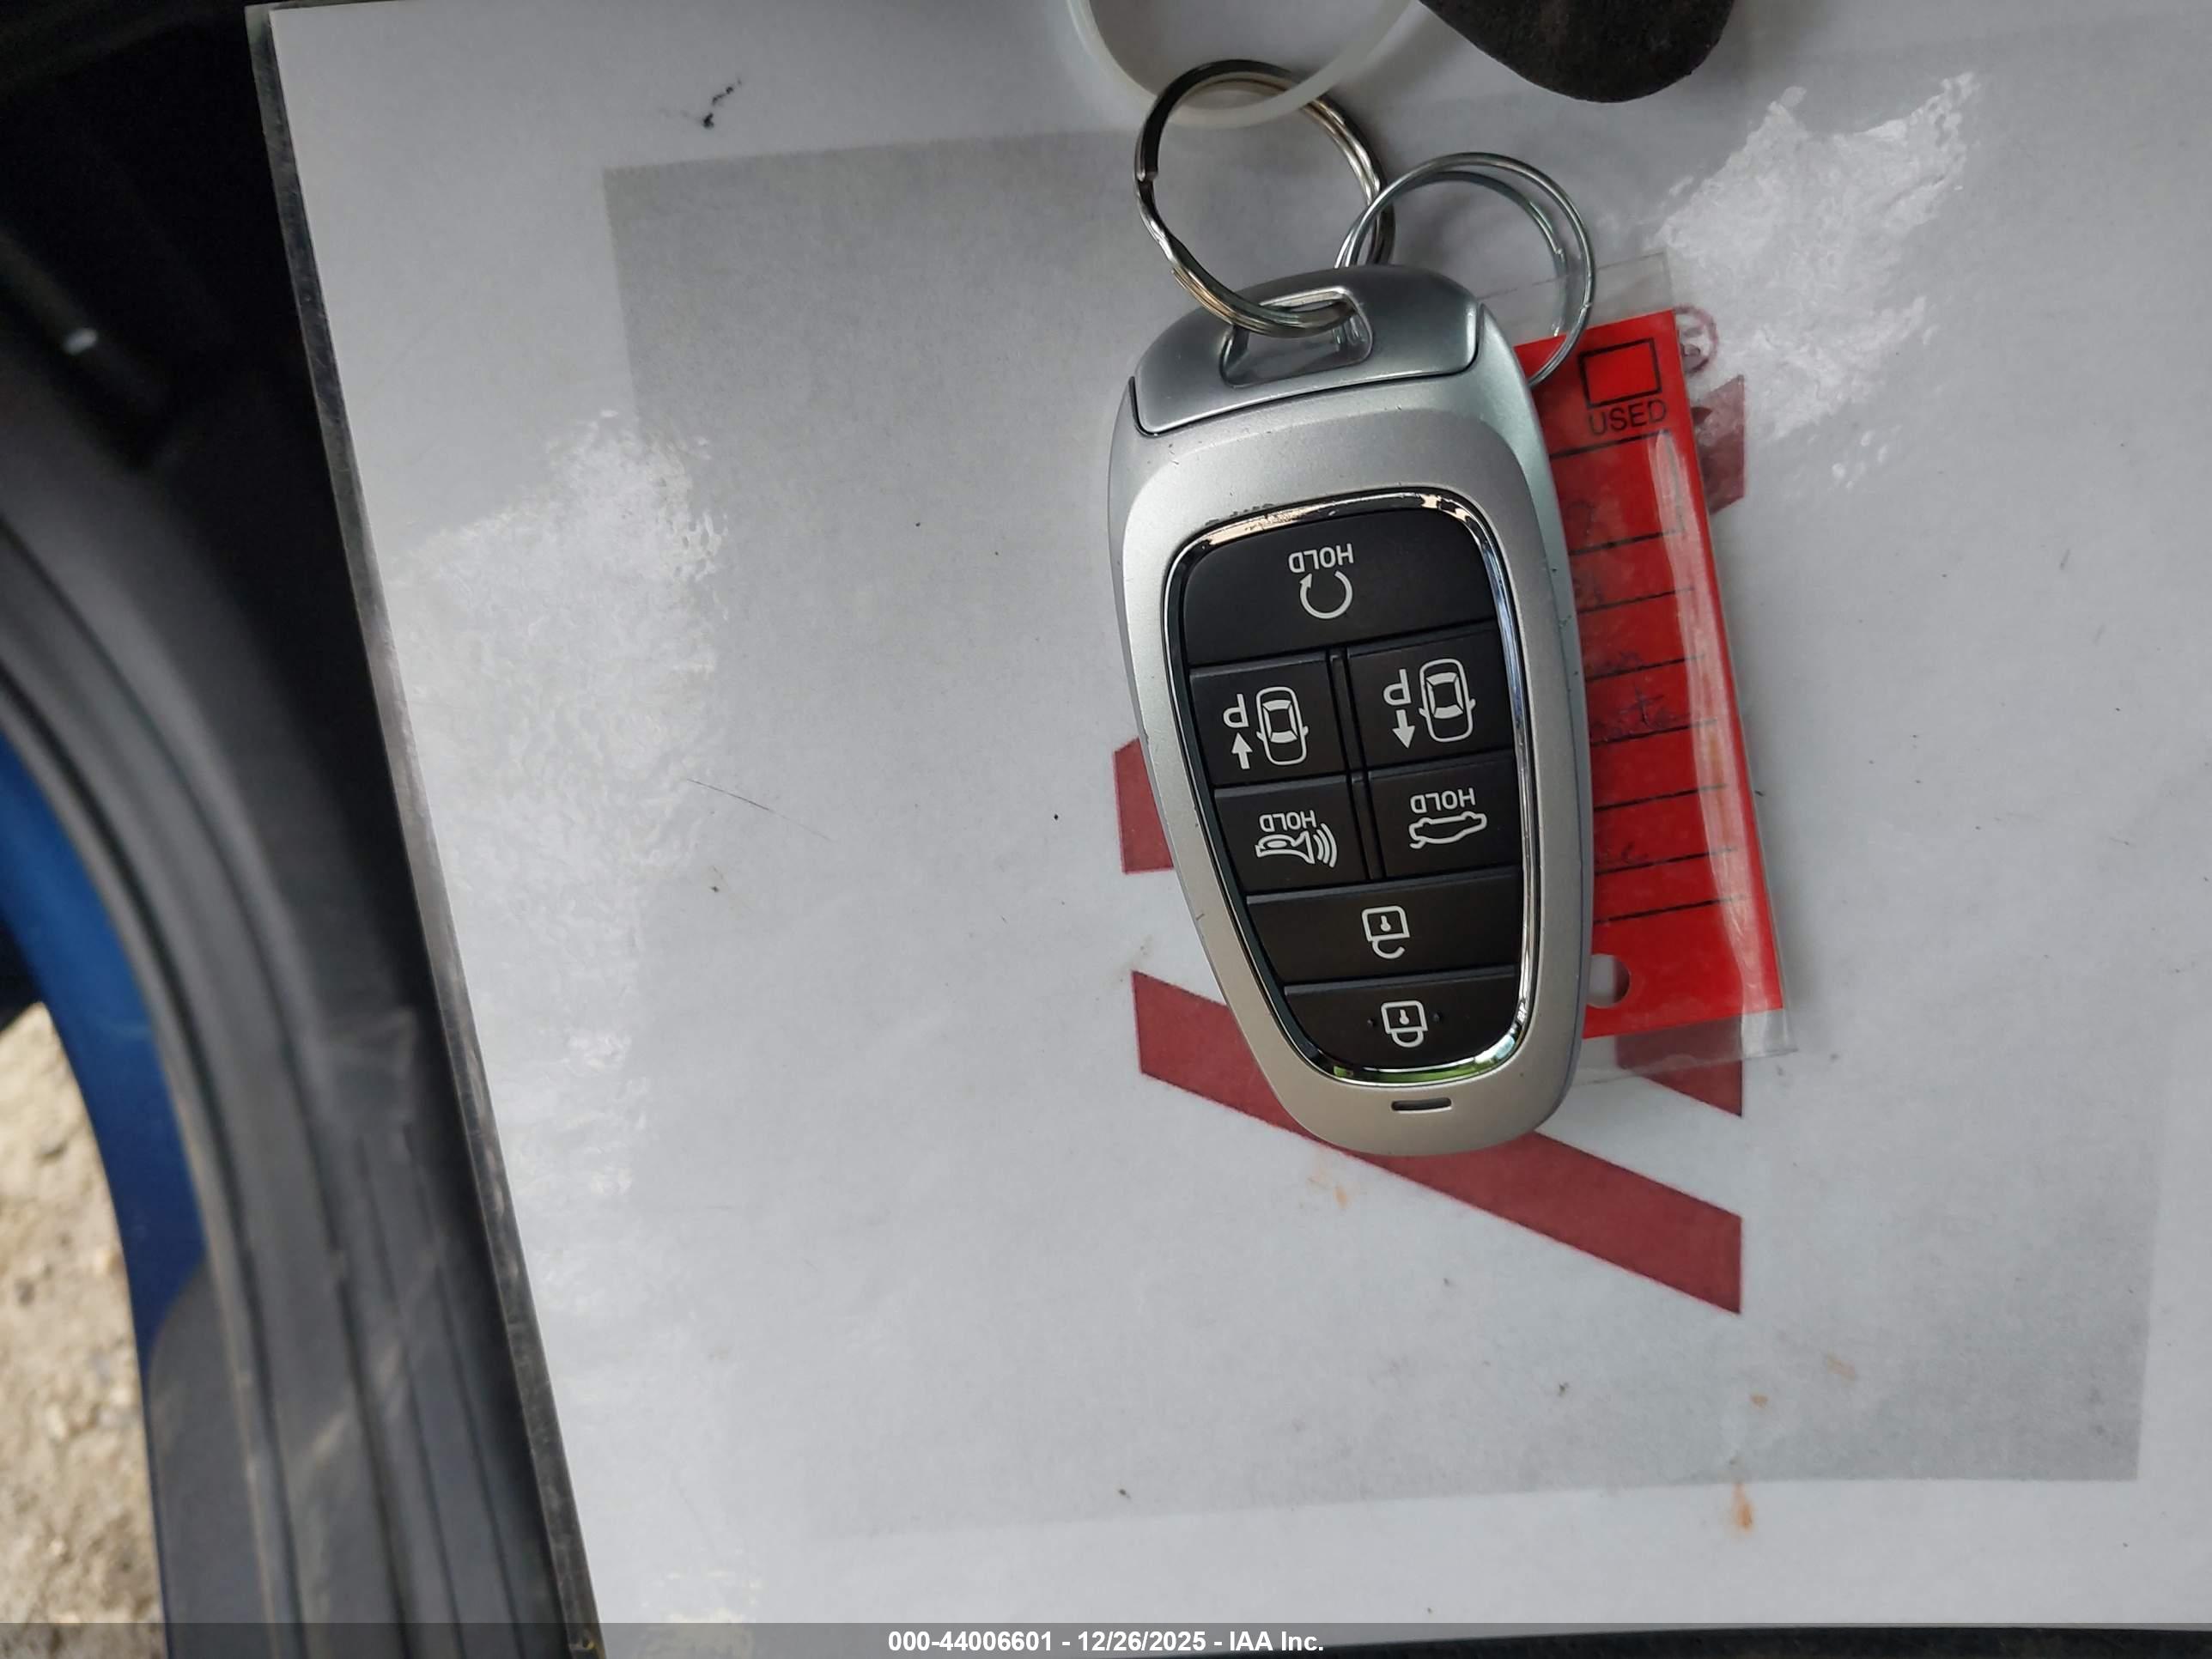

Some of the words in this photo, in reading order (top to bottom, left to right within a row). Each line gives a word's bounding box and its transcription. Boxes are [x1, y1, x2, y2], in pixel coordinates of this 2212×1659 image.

[1589, 399, 1667, 435] USED
[1288, 543, 1354, 574] HOLD
[1383, 668, 1412, 706] P
[1223, 693, 1249, 728] P
[1410, 787, 1476, 813] HOLD
[1259, 810, 1317, 832] HOLD
